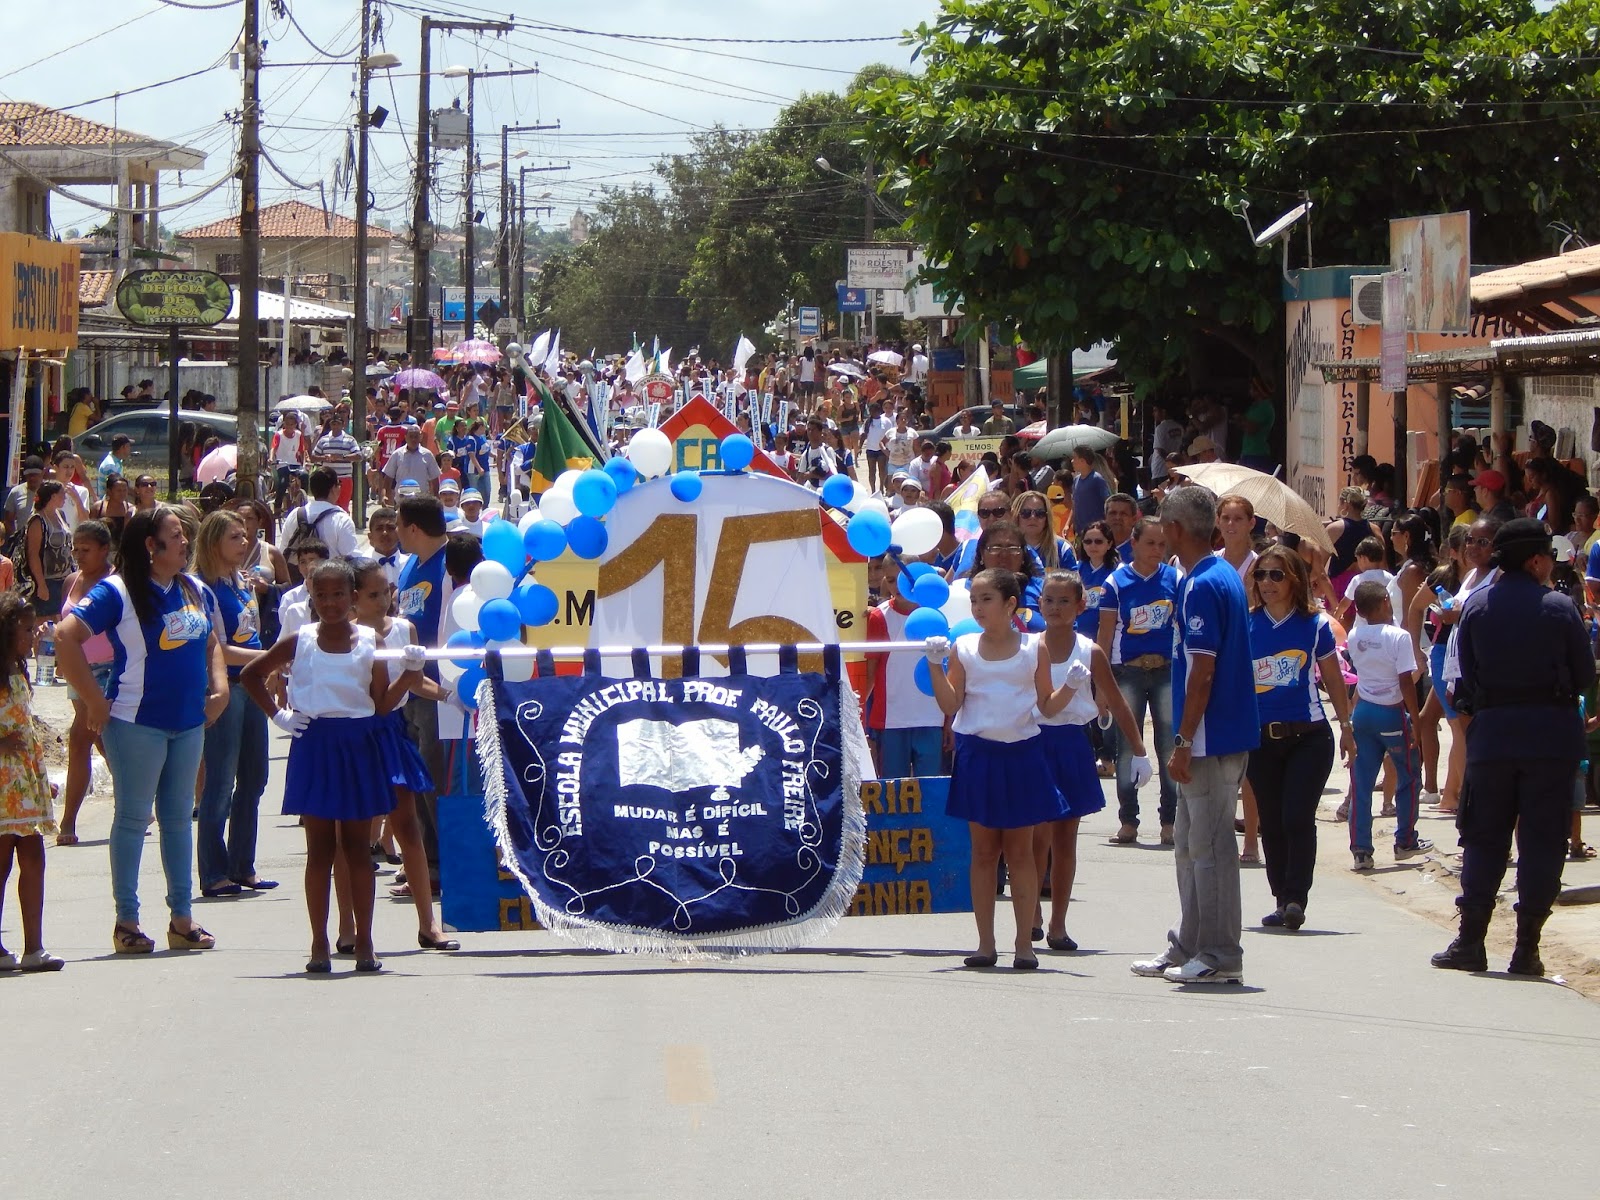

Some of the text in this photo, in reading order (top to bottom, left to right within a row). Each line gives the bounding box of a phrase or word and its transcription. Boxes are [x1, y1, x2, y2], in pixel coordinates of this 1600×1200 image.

[144, 274, 203, 283] PADARIA
[146, 307, 200, 316] MASSA
[163, 295, 186, 305] DE
[597, 508, 823, 679] 15
[1152, 605, 1161, 616] 15
[1277, 656, 1288, 671] 15
[559, 680, 674, 746] MUNICIPAL
[750, 696, 806, 753] PAULO
[556, 752, 583, 838] ESCOLA
[782, 759, 806, 831] FREIRE
[860, 778, 922, 815] RIA
[613, 799, 768, 823] MUDAR É DIFÍCIL
[665, 819, 730, 840] MAS É
[648, 840, 744, 859] POSSÍVEL
[862, 828, 933, 874] NÇA
[851, 880, 932, 916] ANIA
